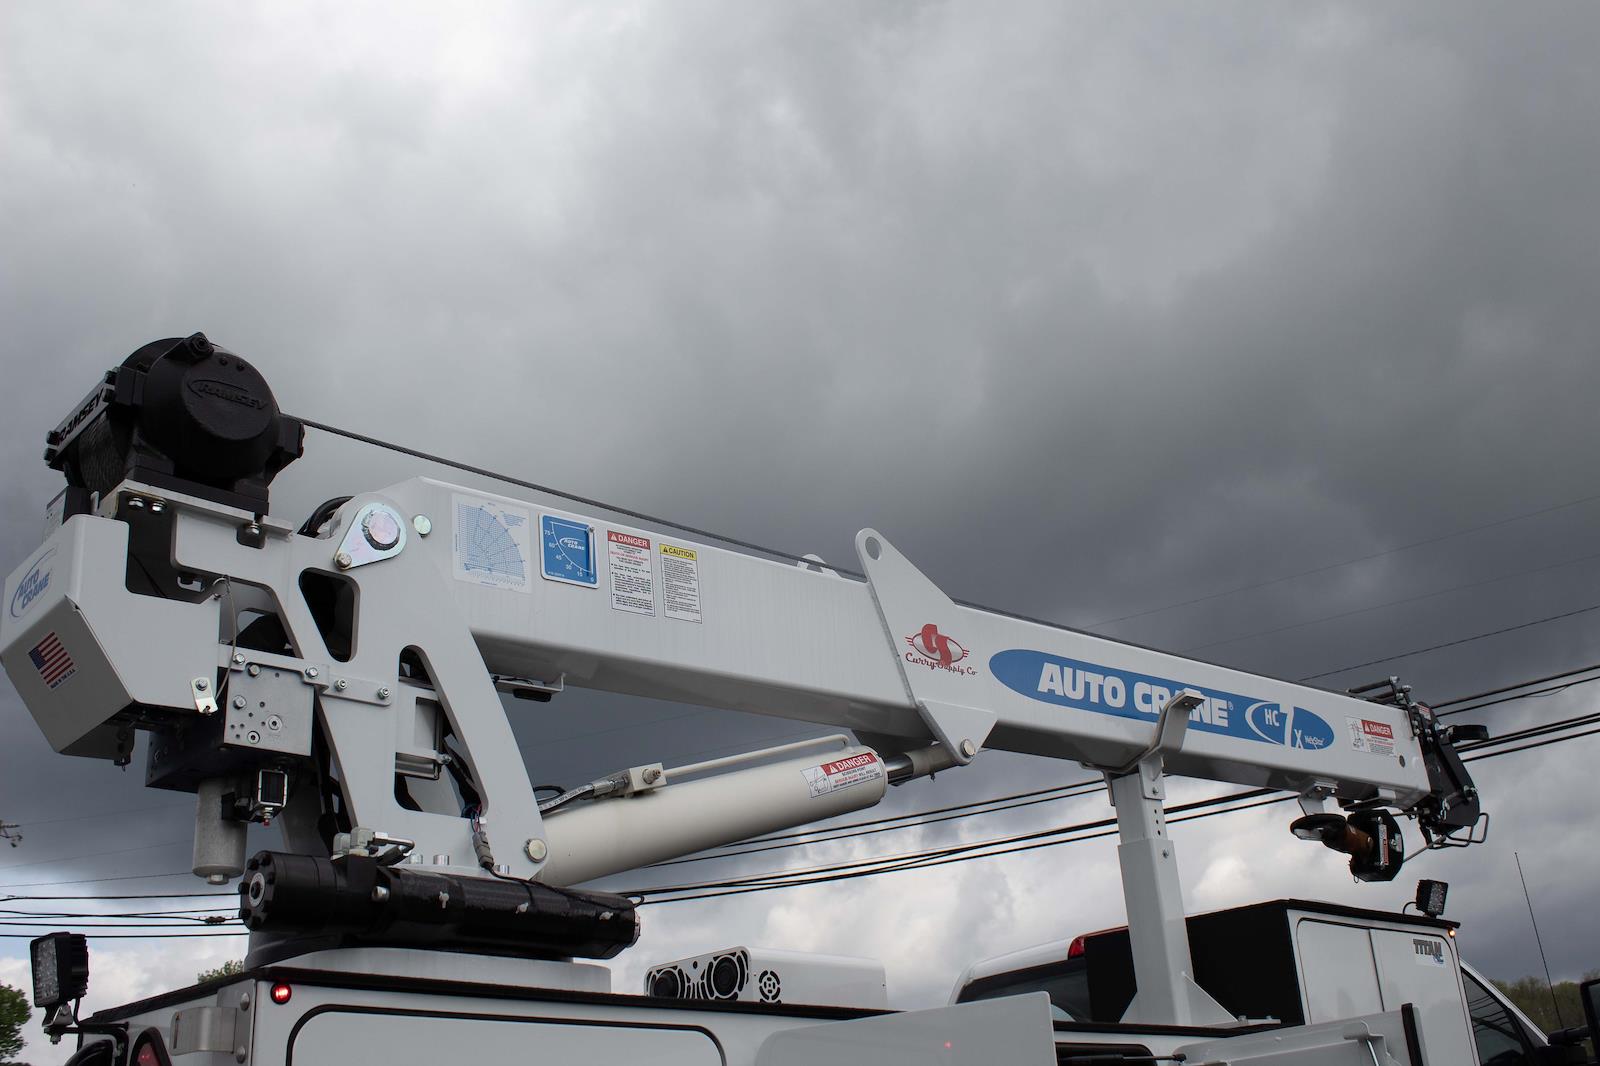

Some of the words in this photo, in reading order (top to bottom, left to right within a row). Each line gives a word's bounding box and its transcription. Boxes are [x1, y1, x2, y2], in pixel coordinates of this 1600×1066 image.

[197, 383, 269, 411] RAMSEY
[59, 387, 105, 442] RAMSEY
[618, 534, 648, 547] DANGER
[668, 547, 694, 558] CAUTION
[17, 568, 40, 601] AUTO
[21, 571, 50, 610] CRANE
[905, 651, 937, 671] Curry
[1037, 662, 1126, 709] AUTO
[1133, 681, 1230, 728] CRNE
[1264, 708, 1280, 727] HC
[1369, 723, 1392, 736] DANGER
[836, 755, 871, 770] DANGER
[1412, 938, 1443, 957] TITAN
